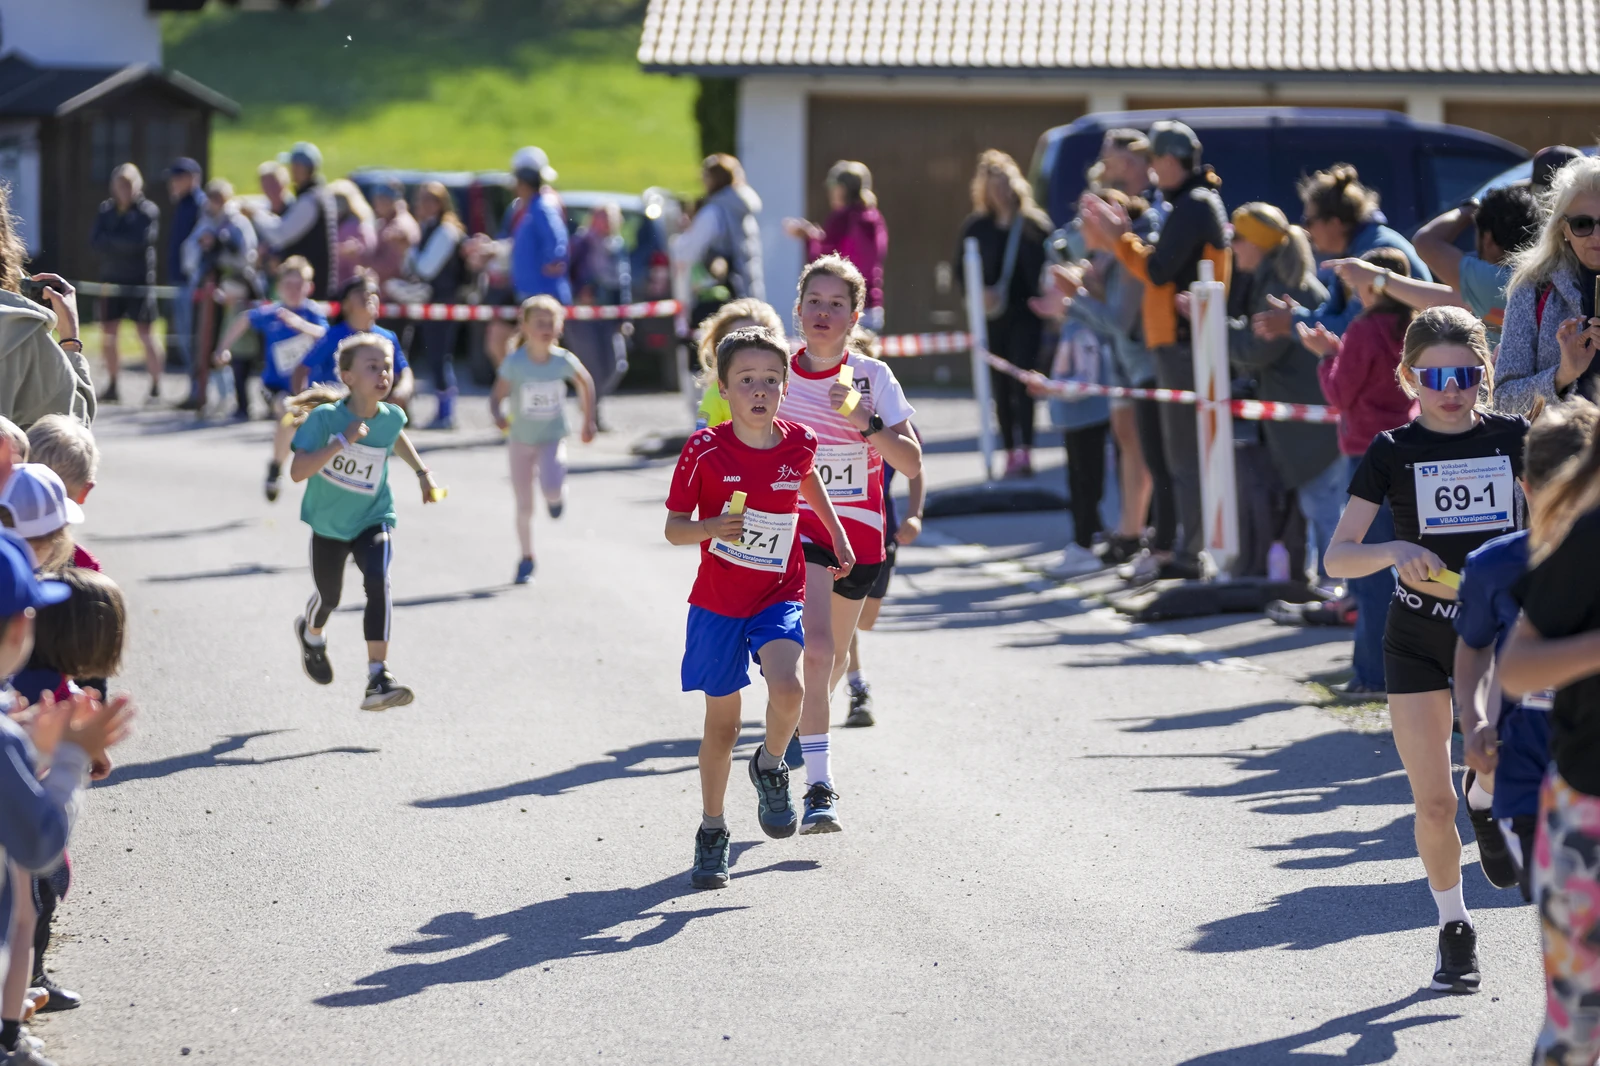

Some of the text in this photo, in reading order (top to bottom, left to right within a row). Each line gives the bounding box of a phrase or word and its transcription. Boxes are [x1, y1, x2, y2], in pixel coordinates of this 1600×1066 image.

[332, 455, 374, 479] 60-1
[815, 464, 853, 486] 0-1
[1441, 466, 1498, 476] Allgäu-Oberschwaben
[1434, 481, 1496, 512] 69-1
[1459, 514, 1498, 523] Voralpencup
[727, 547, 773, 564] VBAO Voralpencup
